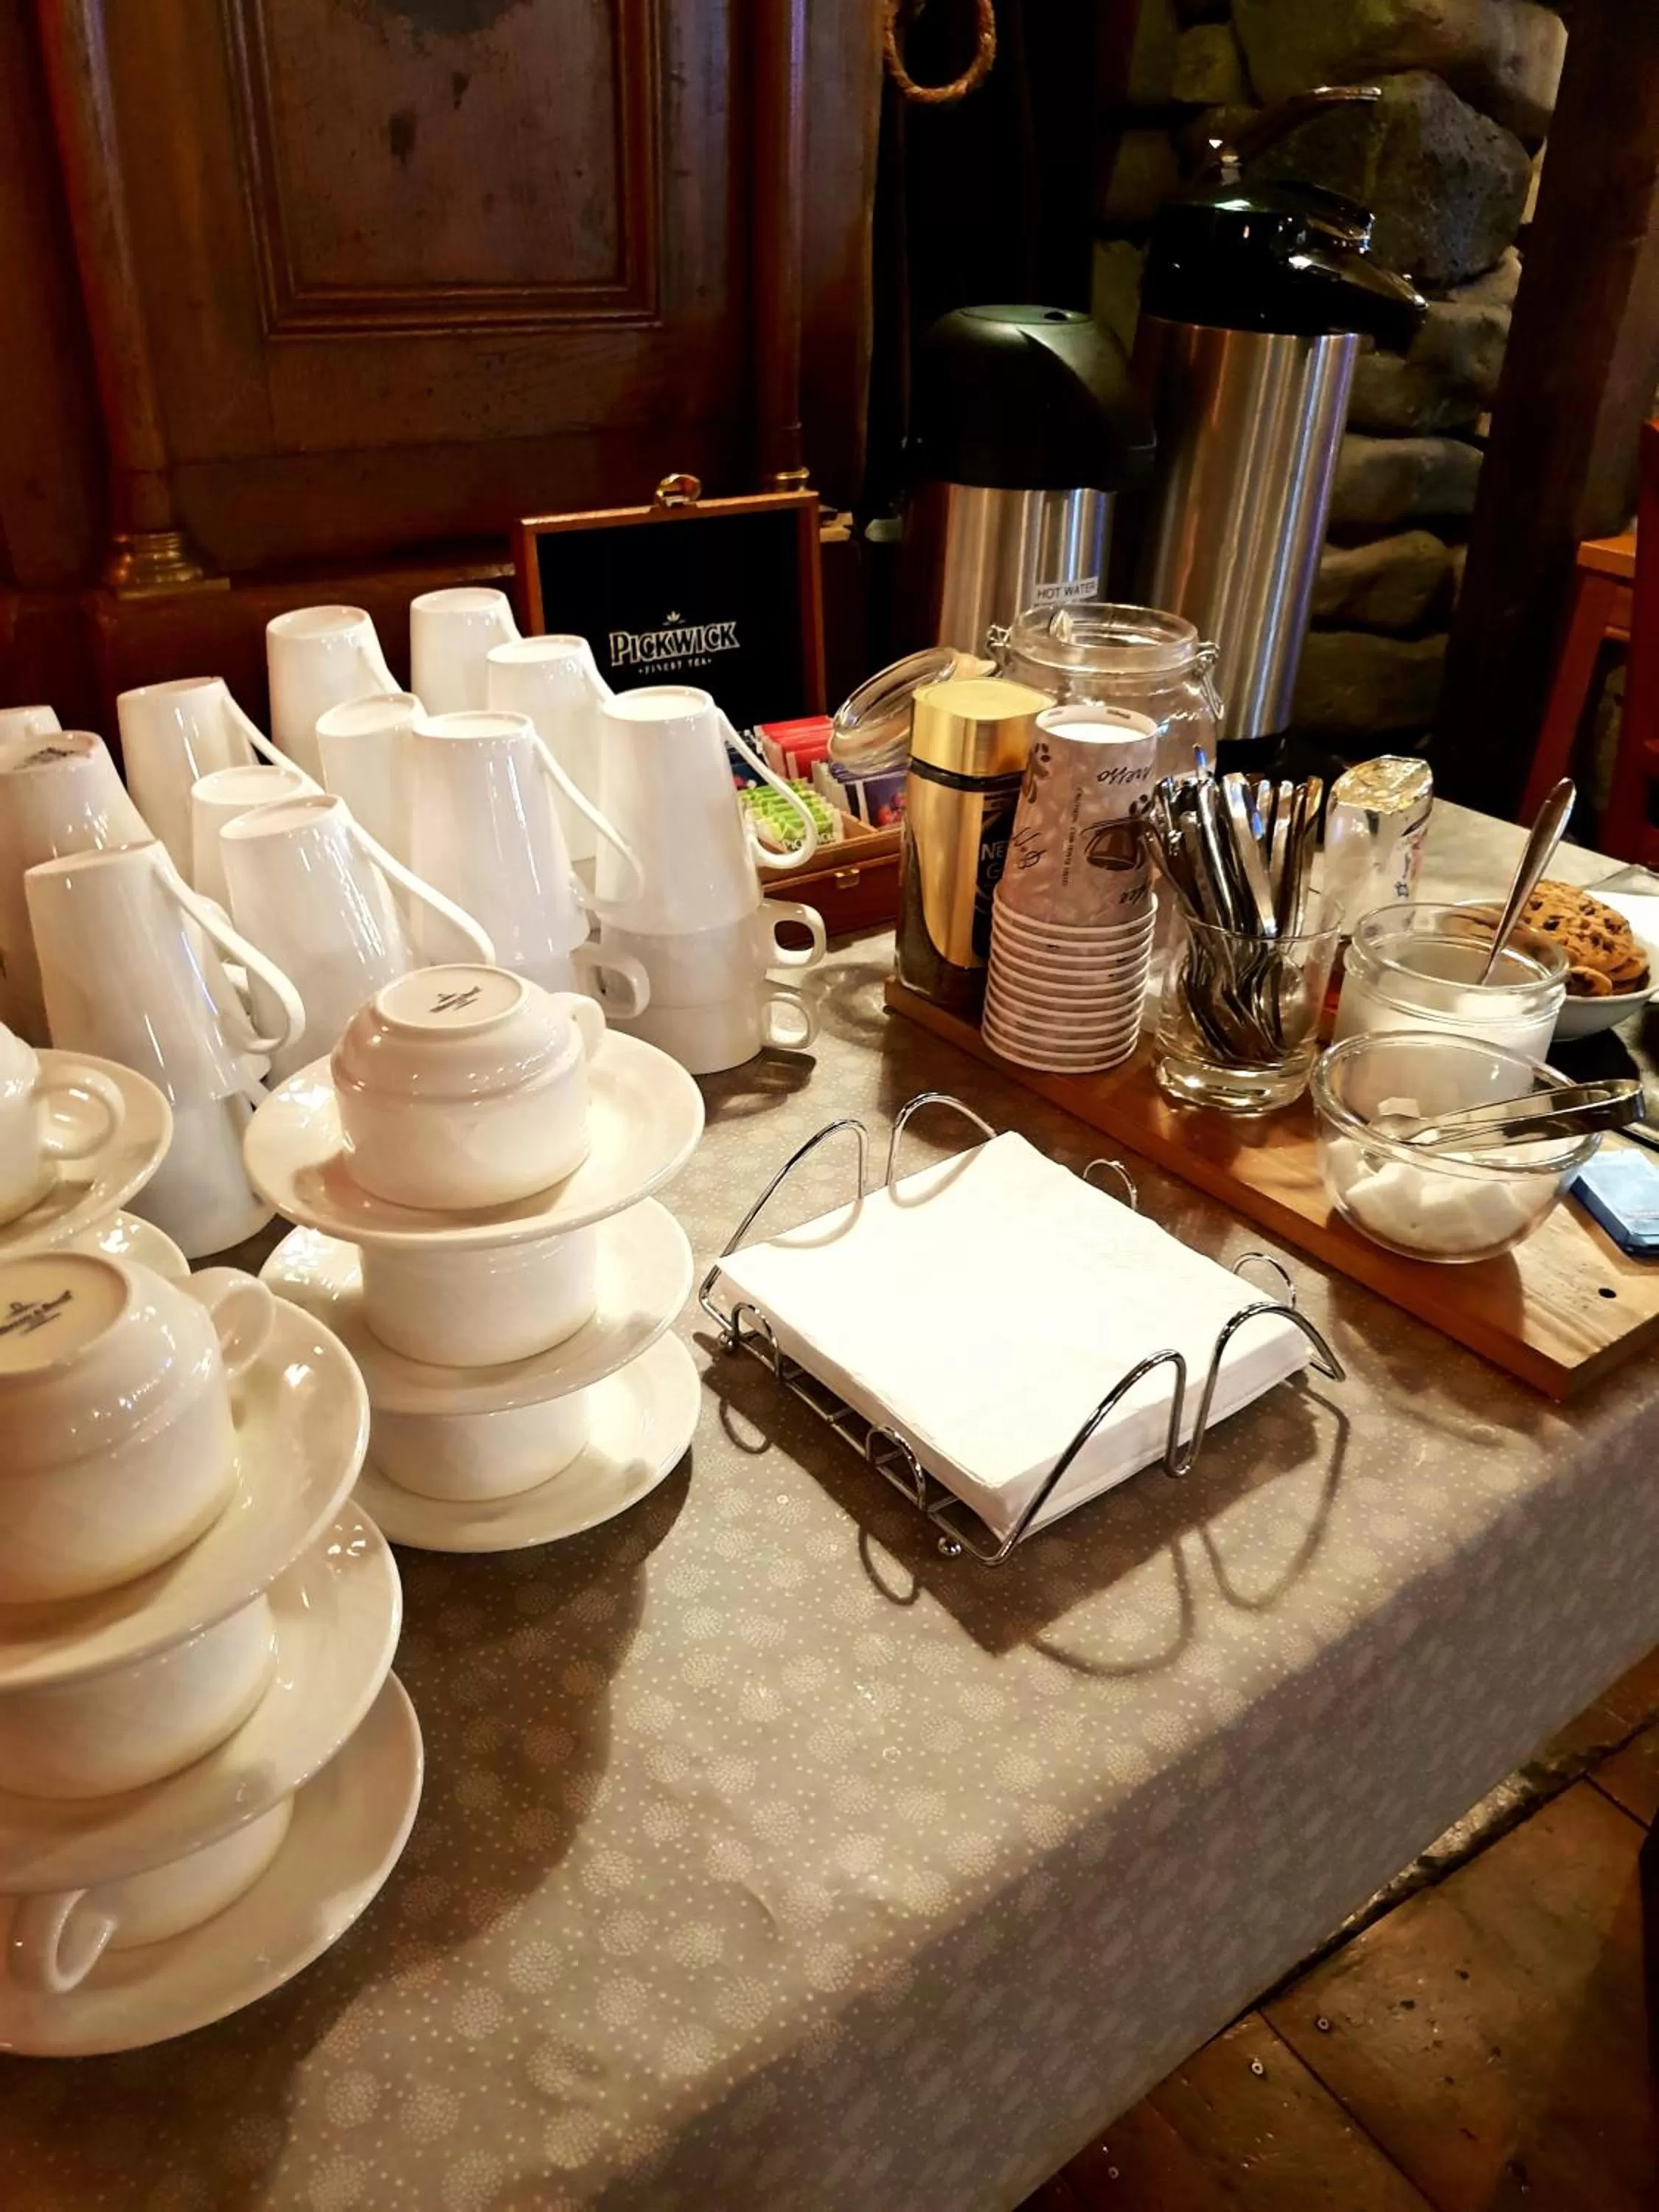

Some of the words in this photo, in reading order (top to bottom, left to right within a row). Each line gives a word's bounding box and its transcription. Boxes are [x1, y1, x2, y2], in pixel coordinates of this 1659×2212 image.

[1037, 587, 1060, 599] HOT
[1063, 581, 1096, 597] WATER
[609, 622, 740, 667] PICKWICK
